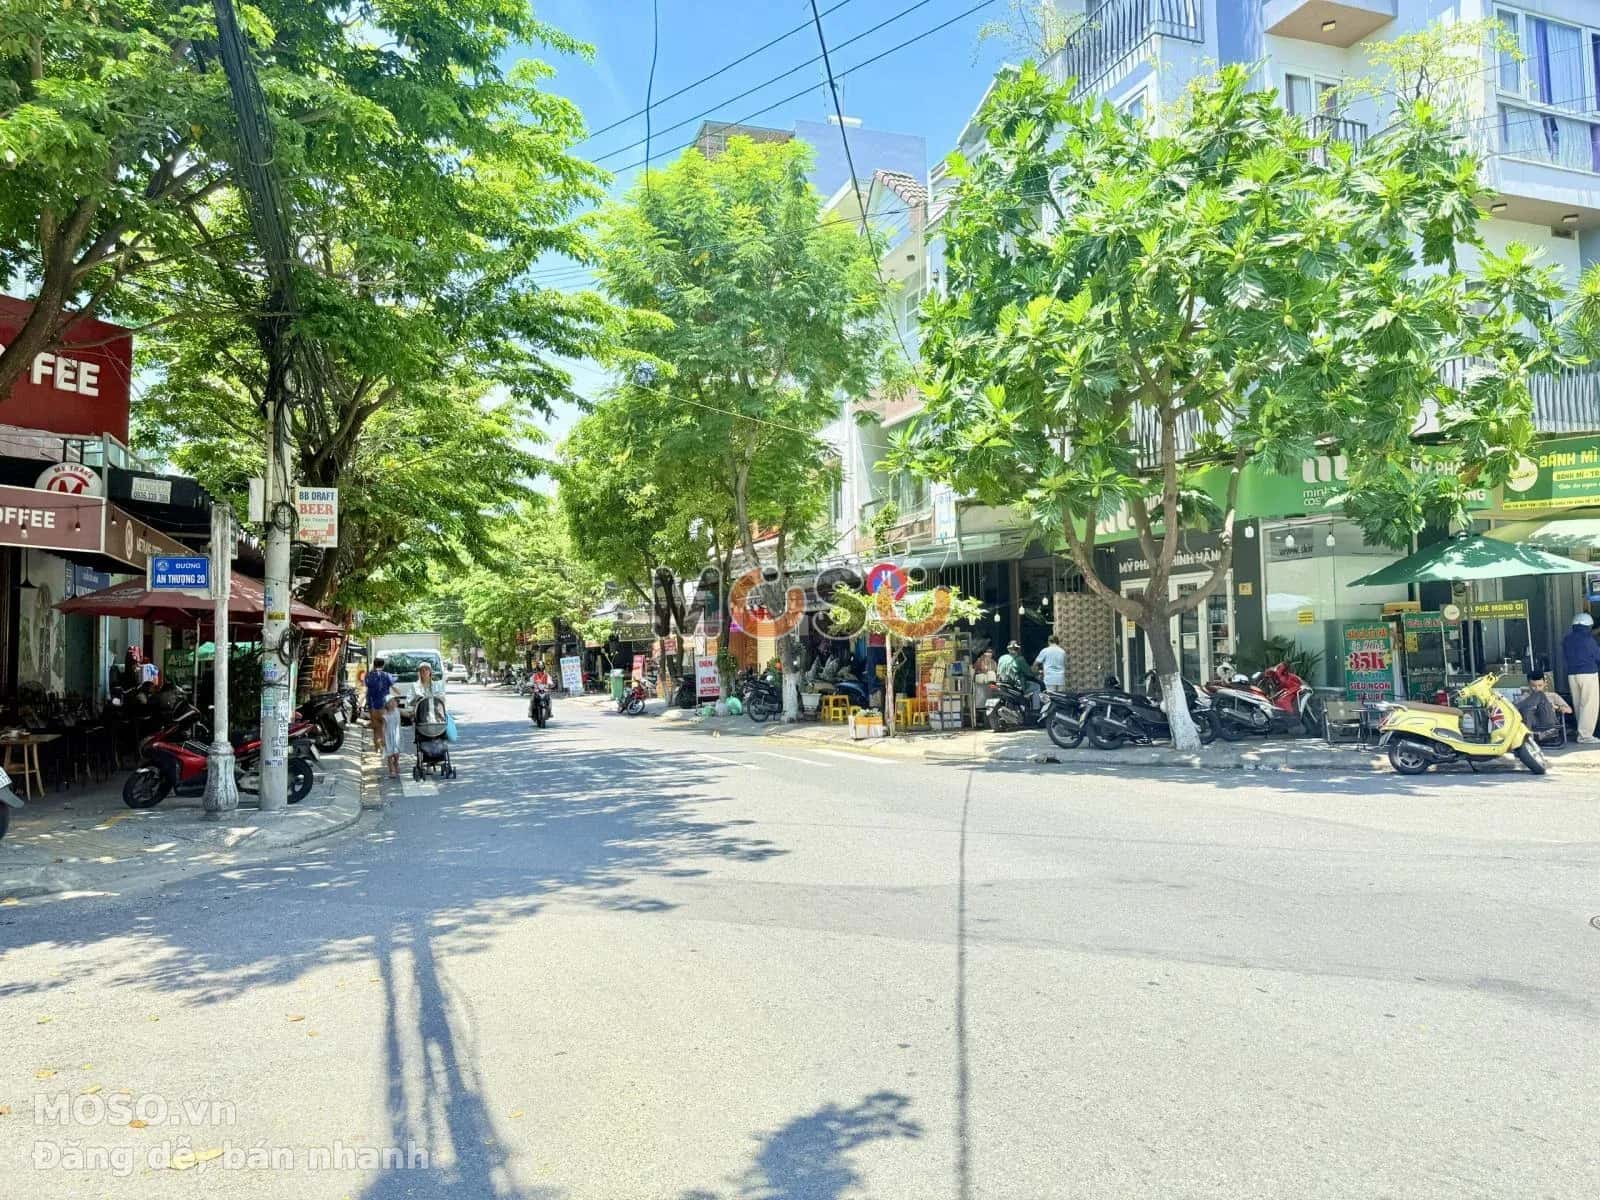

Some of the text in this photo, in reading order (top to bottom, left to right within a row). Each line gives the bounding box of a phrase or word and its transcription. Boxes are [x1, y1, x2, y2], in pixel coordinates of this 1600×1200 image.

[311, 491, 334, 501] DRAFT
[300, 503, 333, 515] BEER
[156, 574, 167, 584] AN
[196, 573, 206, 584] 20
